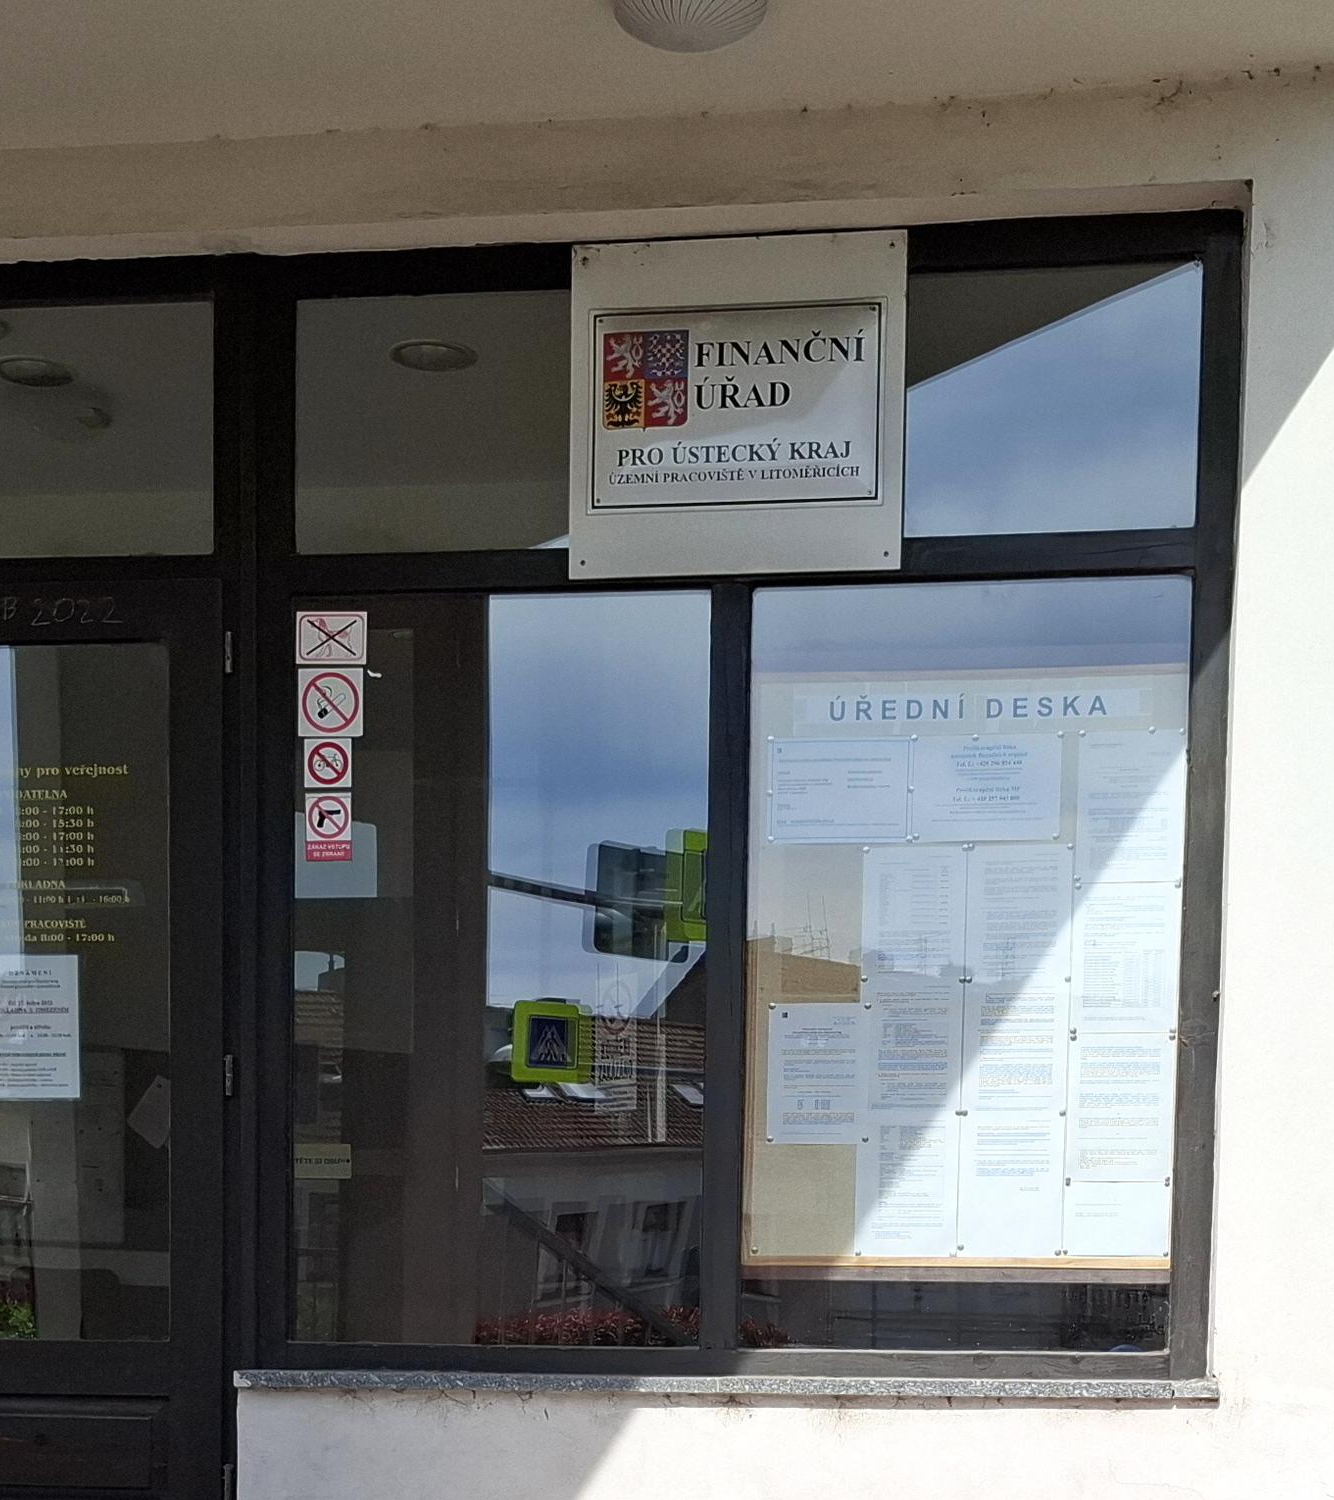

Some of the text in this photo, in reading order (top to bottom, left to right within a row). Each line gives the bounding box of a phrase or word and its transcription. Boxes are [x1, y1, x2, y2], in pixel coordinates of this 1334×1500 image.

[694, 329, 866, 368] FINANČNÍ
[694, 376, 791, 410] ÚŘAD
[617, 437, 852, 467] PRO ÚSTECKÝ KRAJ
[608, 464, 861, 485] ÚZEMNÍ PRACOVIŠTĚ V LITOMĚŘICÍCH
[31, 597, 123, 626] 2022
[829, 692, 1107, 721] ÚŘEDNÍ DESKA
[36, 766, 60, 778] pro
[65, 764, 129, 778] veřejnost
[52, 806, 83, 815] 17:00
[52, 819, 83, 828] 15:30
[52, 832, 83, 841] 17:00
[25, 918, 87, 929] PRACOVIŠTĚ
[76, 933, 105, 941] 17:00
